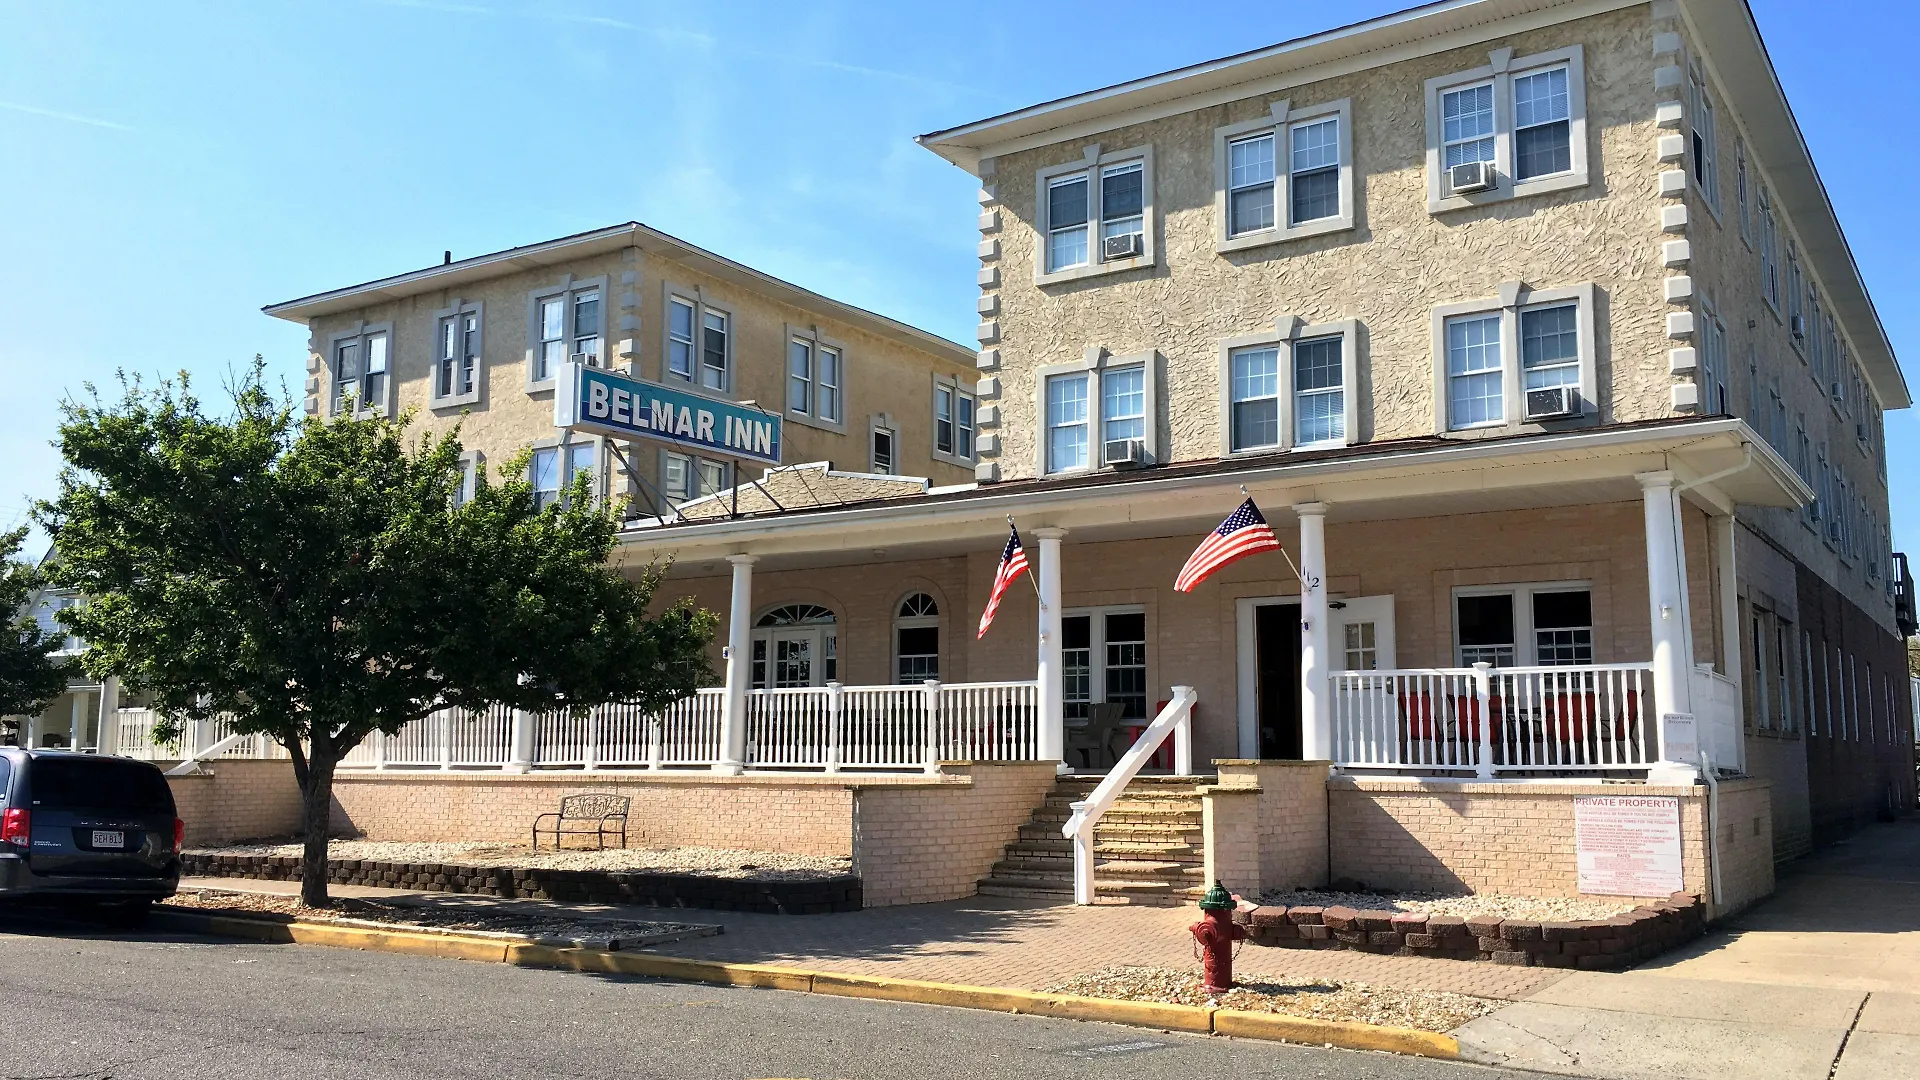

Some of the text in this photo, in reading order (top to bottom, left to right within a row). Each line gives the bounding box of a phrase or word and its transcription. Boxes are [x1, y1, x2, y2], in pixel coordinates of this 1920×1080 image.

[588, 379, 772, 456] BELMAR INN
[1303, 566, 1320, 588] 112
[1575, 798, 1678, 808] PRIVATE PROPERTY!
